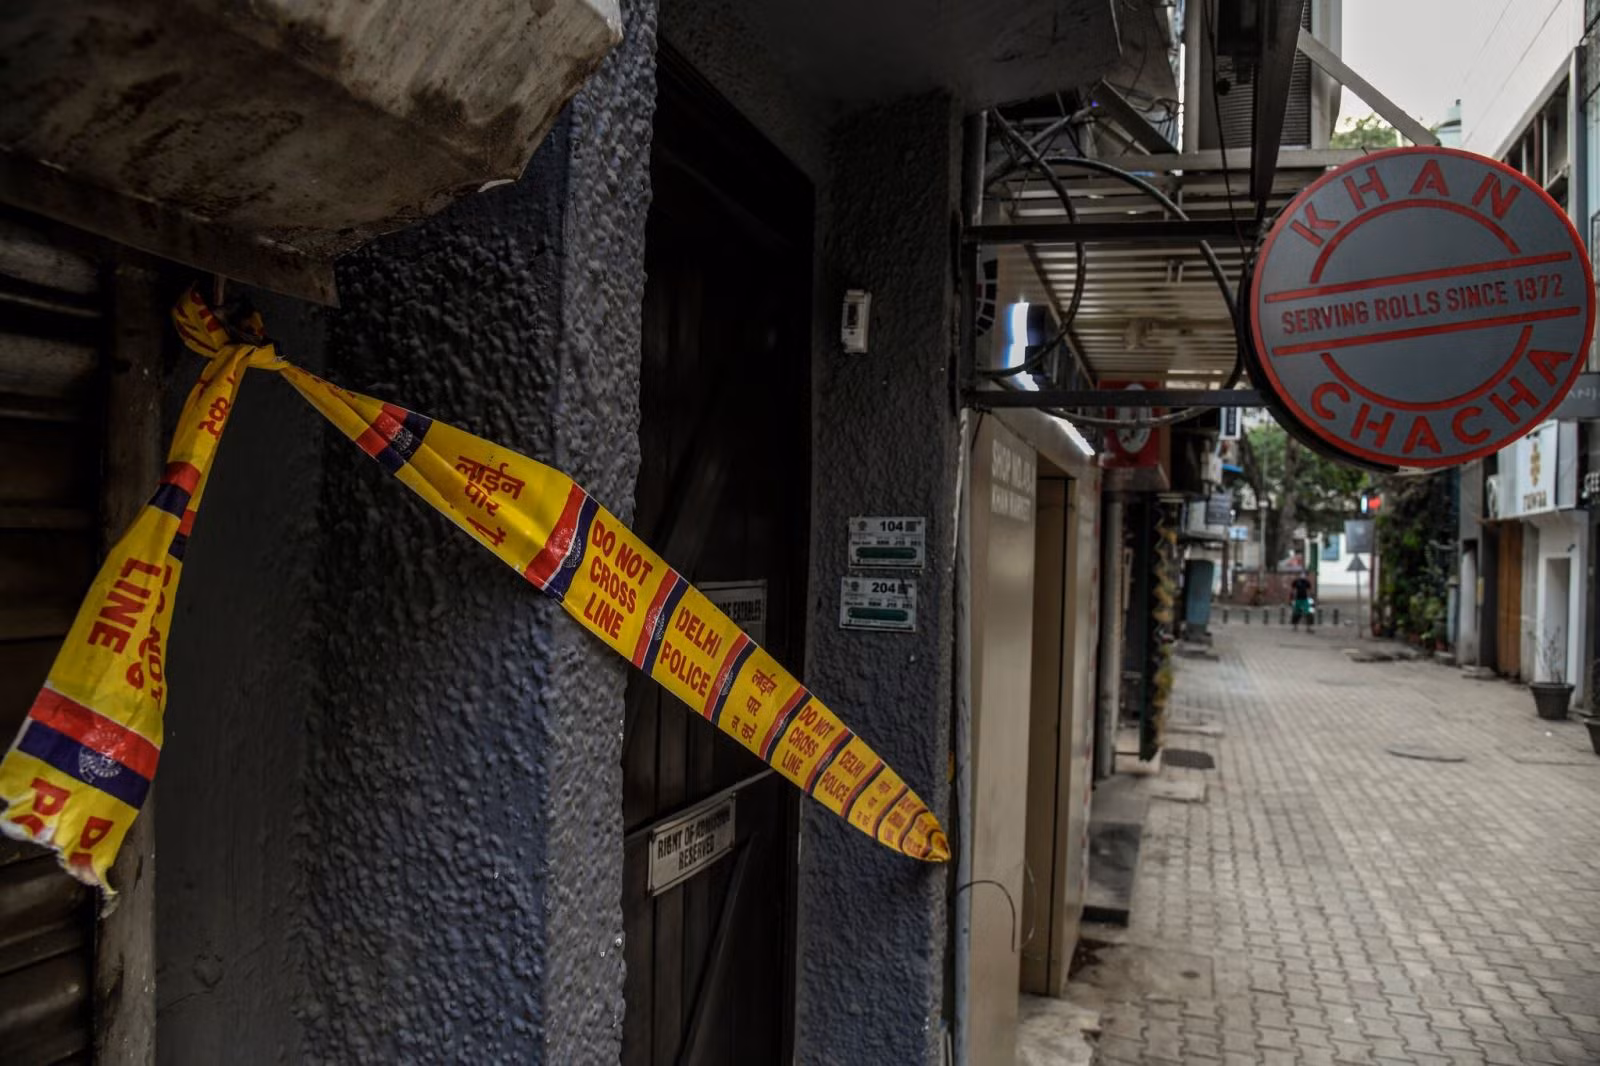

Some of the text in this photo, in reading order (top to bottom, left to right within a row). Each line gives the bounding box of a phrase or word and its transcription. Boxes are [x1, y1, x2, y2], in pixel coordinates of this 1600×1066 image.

[1290, 159, 1521, 247] KHAN
[1281, 273, 1565, 335] SERVING ROLLS SINCE 1972
[1310, 349, 1574, 455] CHACHA
[880, 520, 904, 532] 104
[591, 519, 654, 586] DO NOT
[87, 557, 161, 655] LINE
[589, 555, 637, 615] CROSS
[872, 581, 895, 593] 204
[583, 592, 625, 640] LINE
[674, 606, 723, 660] DELHI
[659, 639, 711, 698] POLICE
[788, 726, 819, 757] CROSS
[797, 704, 836, 740] DO NOT
[781, 751, 804, 777] LINE
[837, 750, 867, 778] DELHI
[820, 771, 851, 803] POLICE
[657, 830, 682, 860] RIGHT
[684, 823, 695, 846] OF
[678, 834, 715, 871] RESERVED
